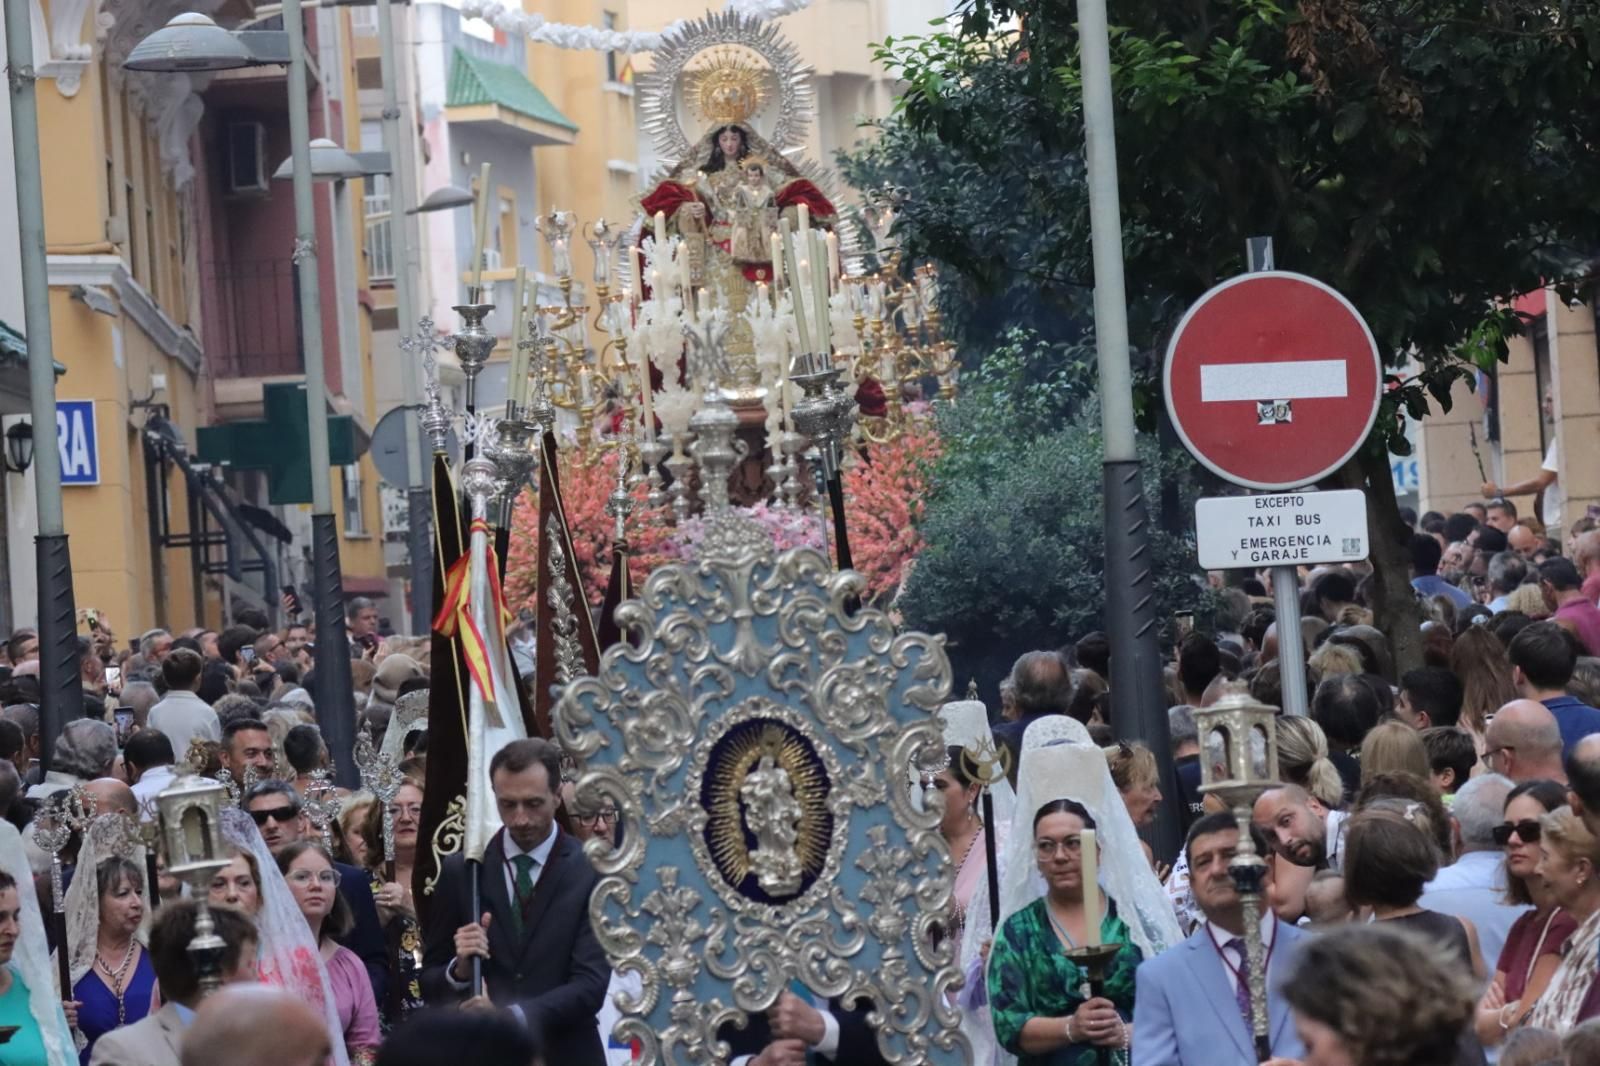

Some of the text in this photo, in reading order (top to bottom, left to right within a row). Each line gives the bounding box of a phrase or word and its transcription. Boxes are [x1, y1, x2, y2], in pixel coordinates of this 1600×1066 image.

[1255, 496, 1304, 509] EXCEPTO
[1248, 513, 1321, 528] TAXI BUS
[1240, 535, 1331, 549] EMERGENCIA
[1231, 548, 1309, 562] Y GARAJE
